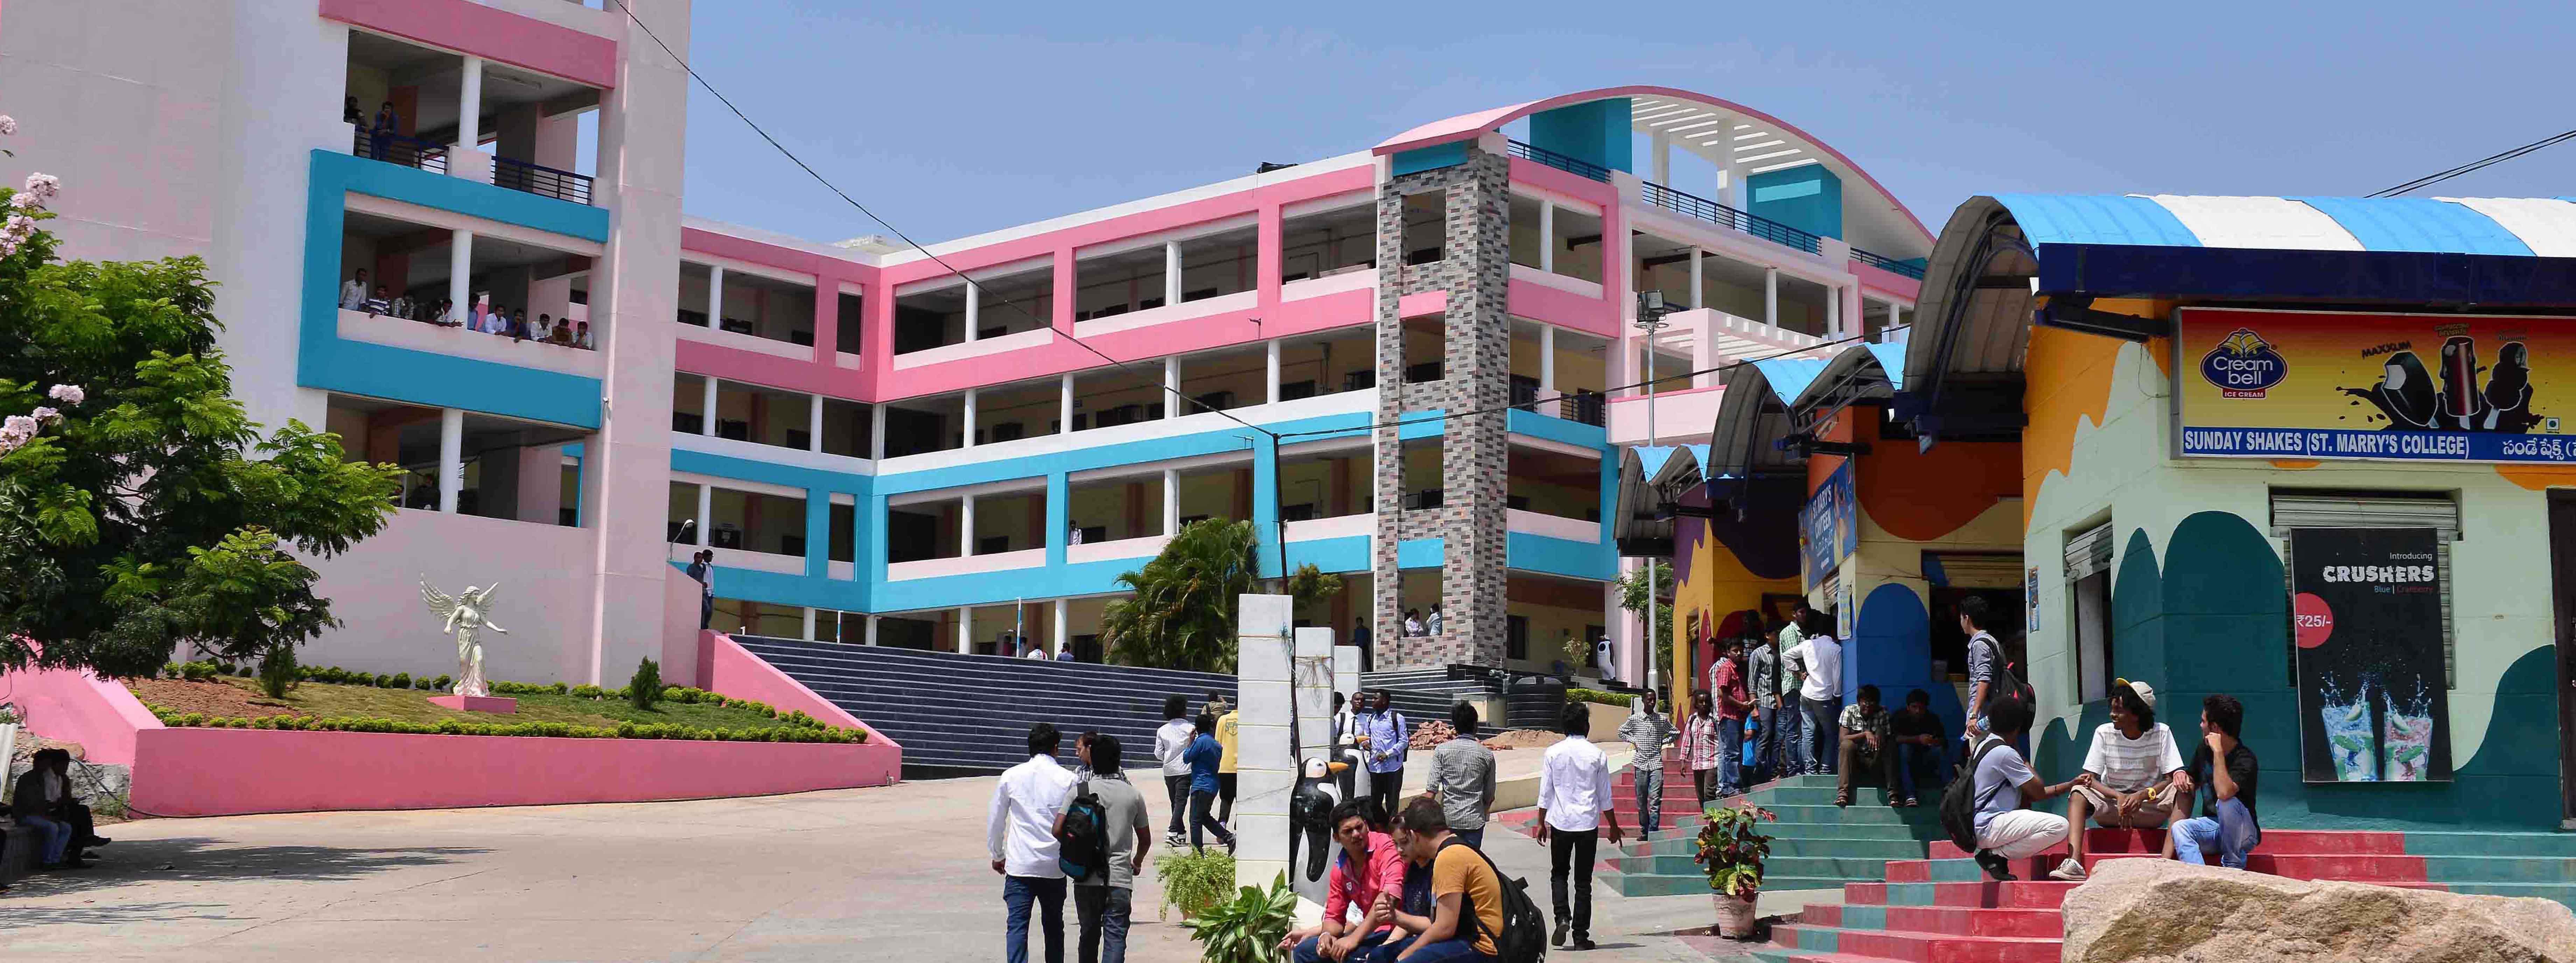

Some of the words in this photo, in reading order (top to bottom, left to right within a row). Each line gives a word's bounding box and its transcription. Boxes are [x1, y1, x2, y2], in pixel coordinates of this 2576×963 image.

[2362, 341, 2412, 359] MAXXUM
[2213, 356, 2273, 371] Cream
[2228, 371, 2261, 385] bell
[2185, 431, 2242, 450] SUNDAY
[2246, 432, 2302, 451] SHAKES
[2306, 433, 2332, 455] (ST.
[2402, 435, 2469, 459] COLLEGE)
[2503, 438, 2537, 455] సండే
[1815, 508, 1831, 540] CANTEEN
[2389, 552, 2432, 561] Introducing
[2323, 565, 2434, 582] CRUSHERS
[2297, 615, 2331, 627] ₹25/-
